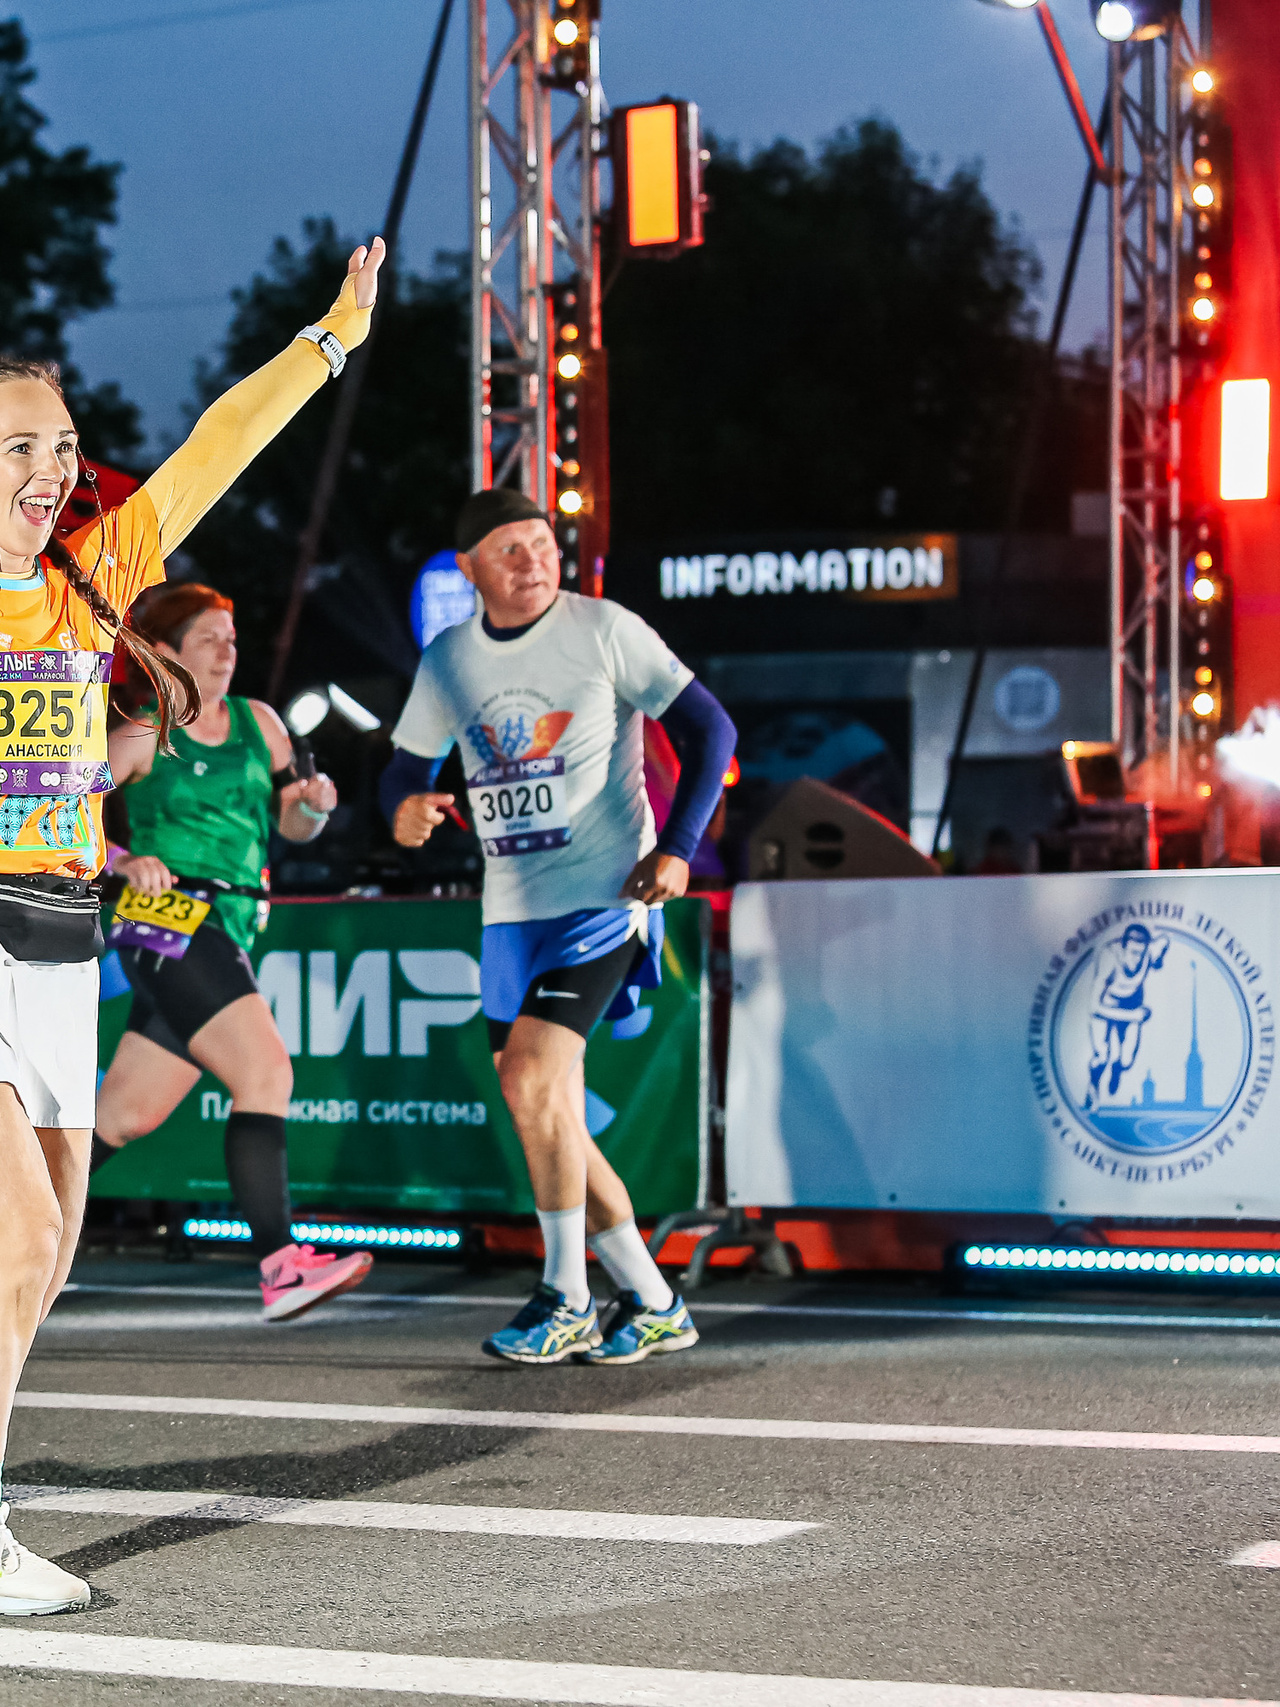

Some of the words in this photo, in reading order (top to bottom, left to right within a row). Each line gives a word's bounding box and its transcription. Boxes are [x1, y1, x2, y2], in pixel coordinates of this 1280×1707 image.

[660, 546, 944, 599] INFORMATION
[5, 743, 83, 758] АНАСТАСИЯ
[480, 783, 553, 822] 3020
[201, 1090, 359, 1123] Плжная
[367, 1100, 488, 1126] система
